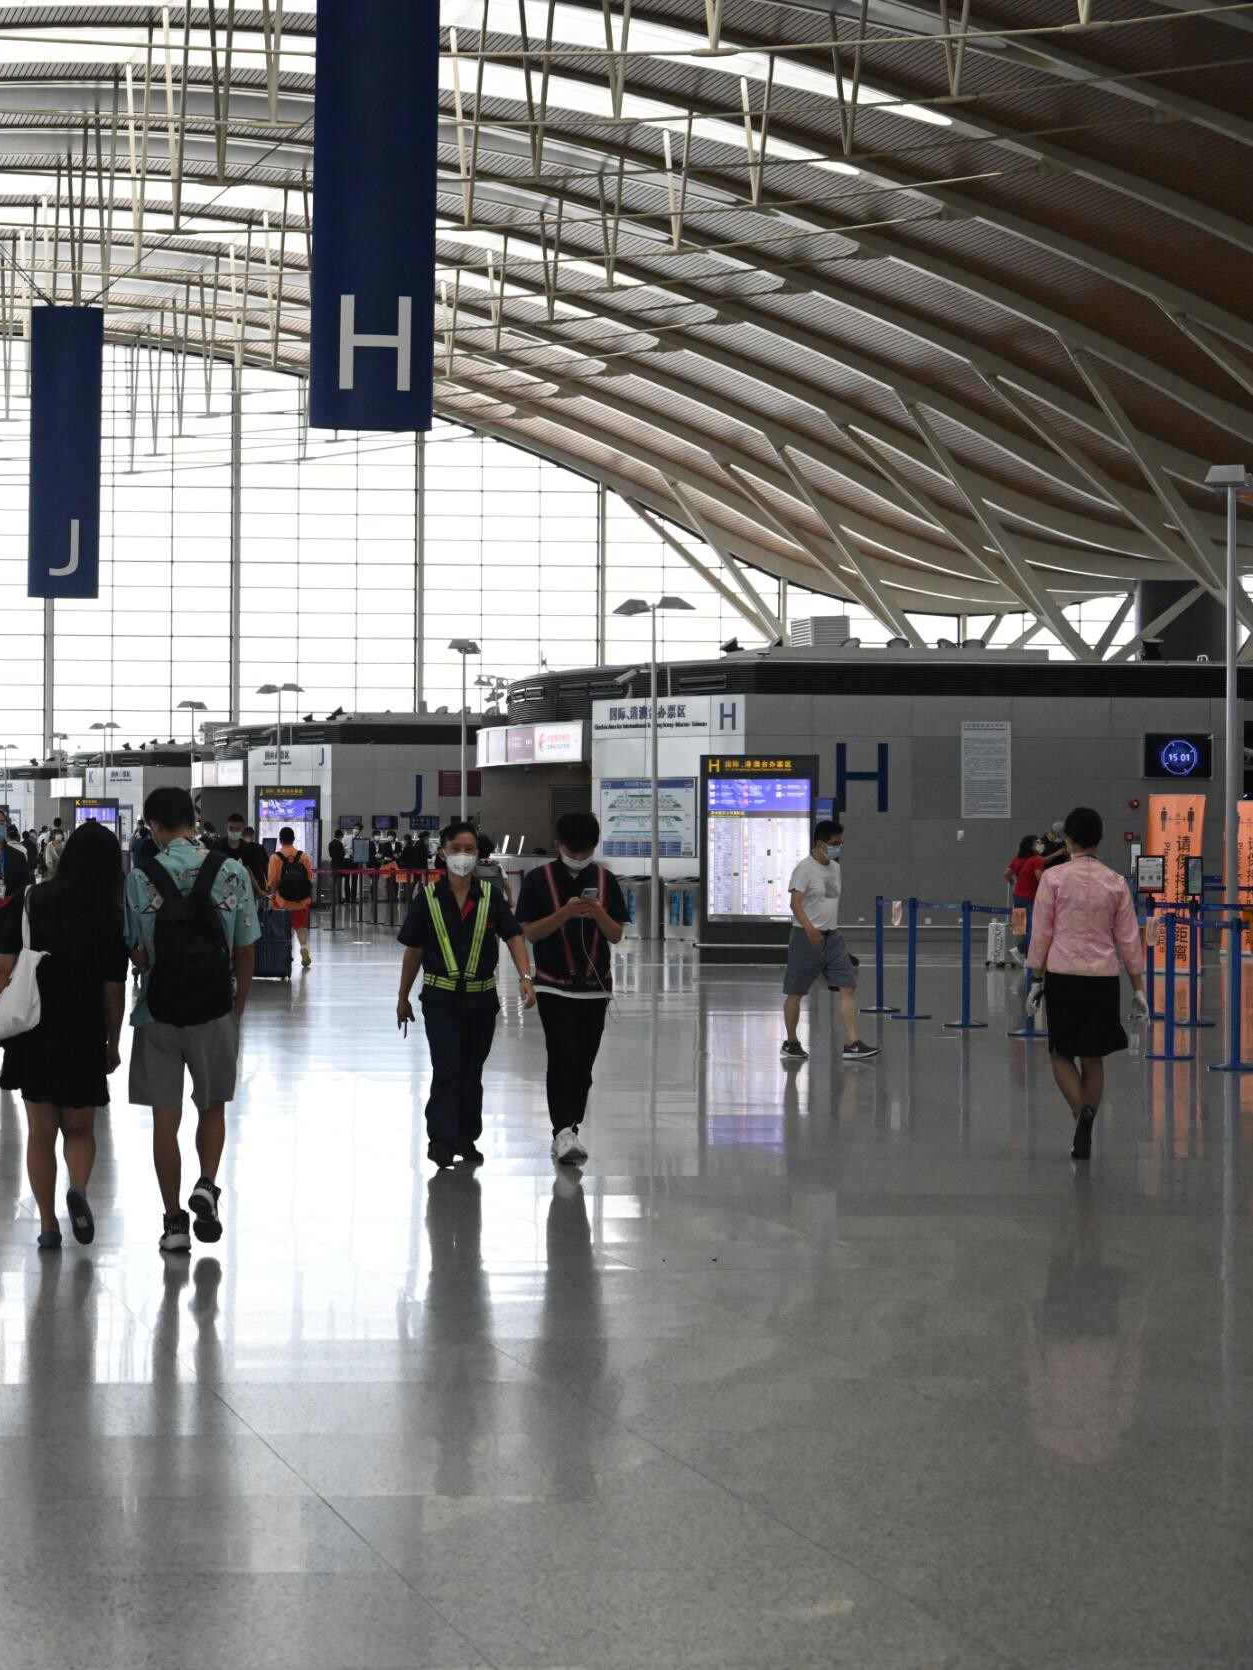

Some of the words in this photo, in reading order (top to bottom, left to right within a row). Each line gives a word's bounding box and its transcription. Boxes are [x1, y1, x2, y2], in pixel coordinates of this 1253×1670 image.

[339, 295, 412, 391] H
[49, 519, 80, 577] J
[719, 702, 736, 730] H
[319, 748, 325, 766] J
[708, 759, 720, 773] H
[836, 743, 888, 812] H
[400, 774, 423, 818] J
